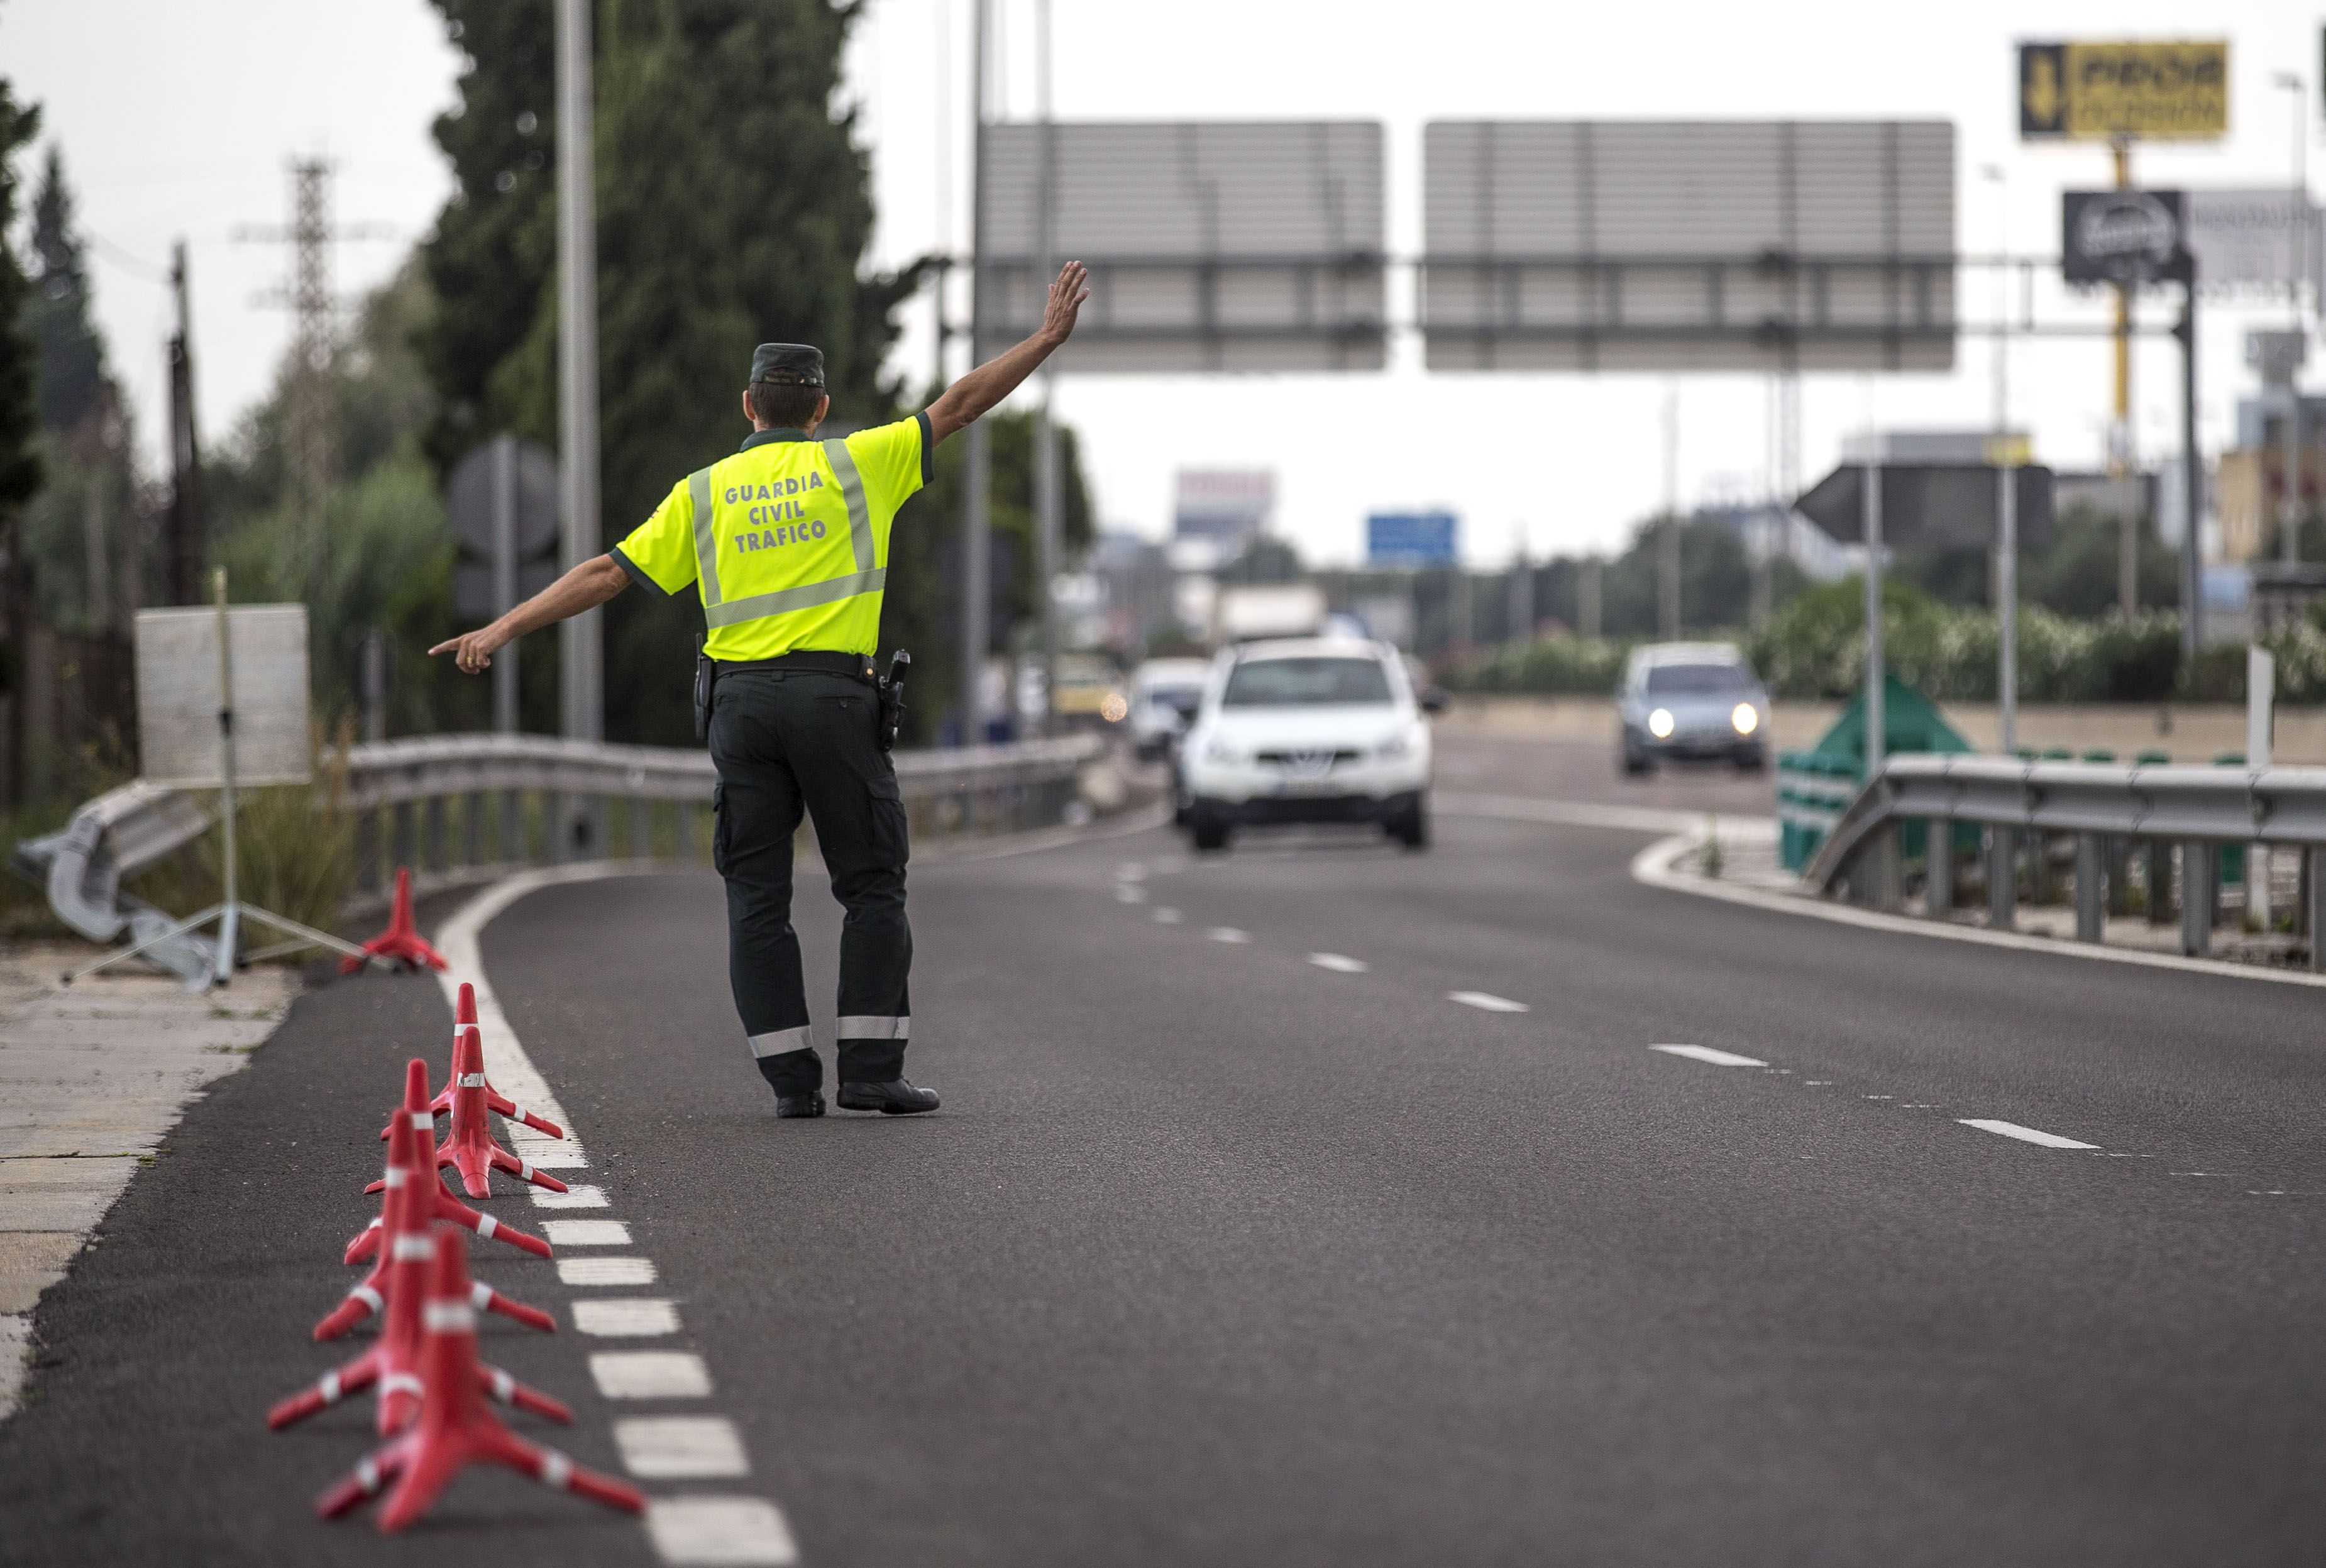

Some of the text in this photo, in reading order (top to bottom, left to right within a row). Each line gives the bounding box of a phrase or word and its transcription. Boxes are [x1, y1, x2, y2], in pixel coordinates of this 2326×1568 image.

[725, 470, 824, 504] GUARDIA
[749, 500, 805, 526] CIVIL
[734, 520, 826, 553] TRAFICO
